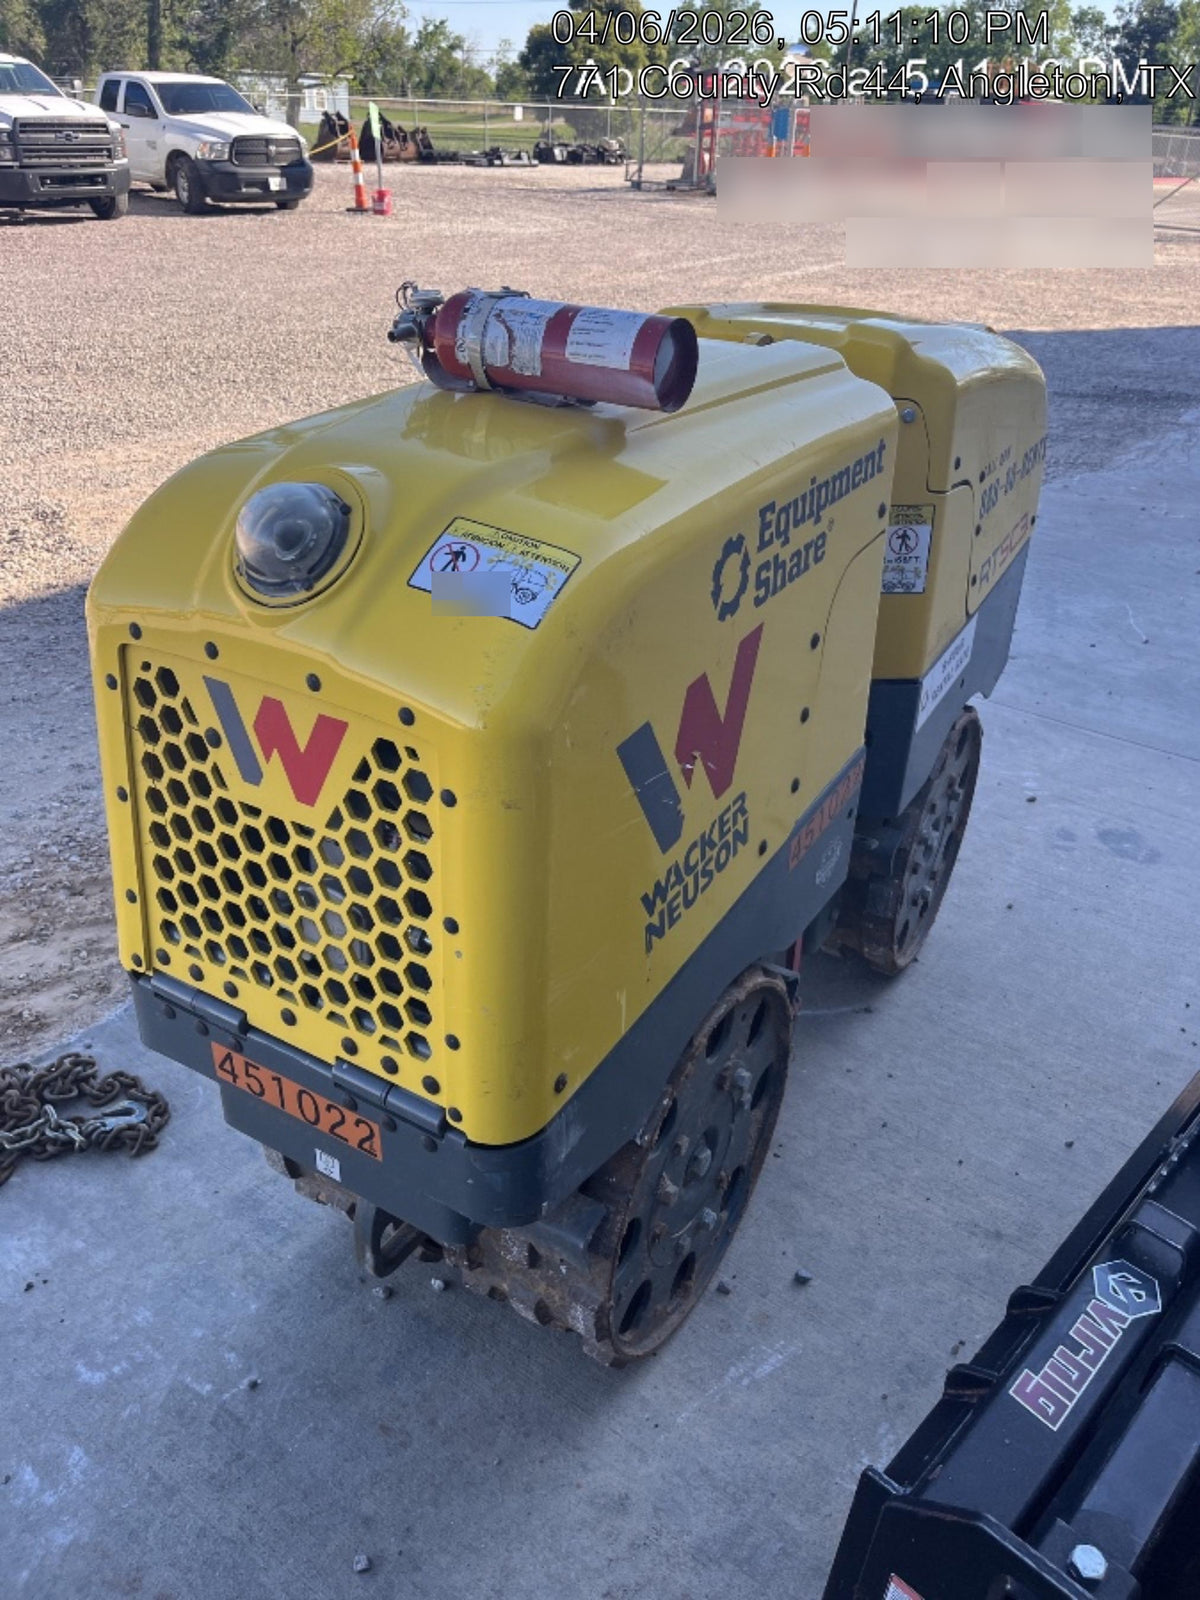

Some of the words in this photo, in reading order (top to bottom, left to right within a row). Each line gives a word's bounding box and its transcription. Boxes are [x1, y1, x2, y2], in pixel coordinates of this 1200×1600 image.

[757, 439, 886, 553] Equipment
[640, 791, 748, 917] WACKER
[645, 816, 749, 953] NEUSON
[218, 1052, 378, 1157] 451022
